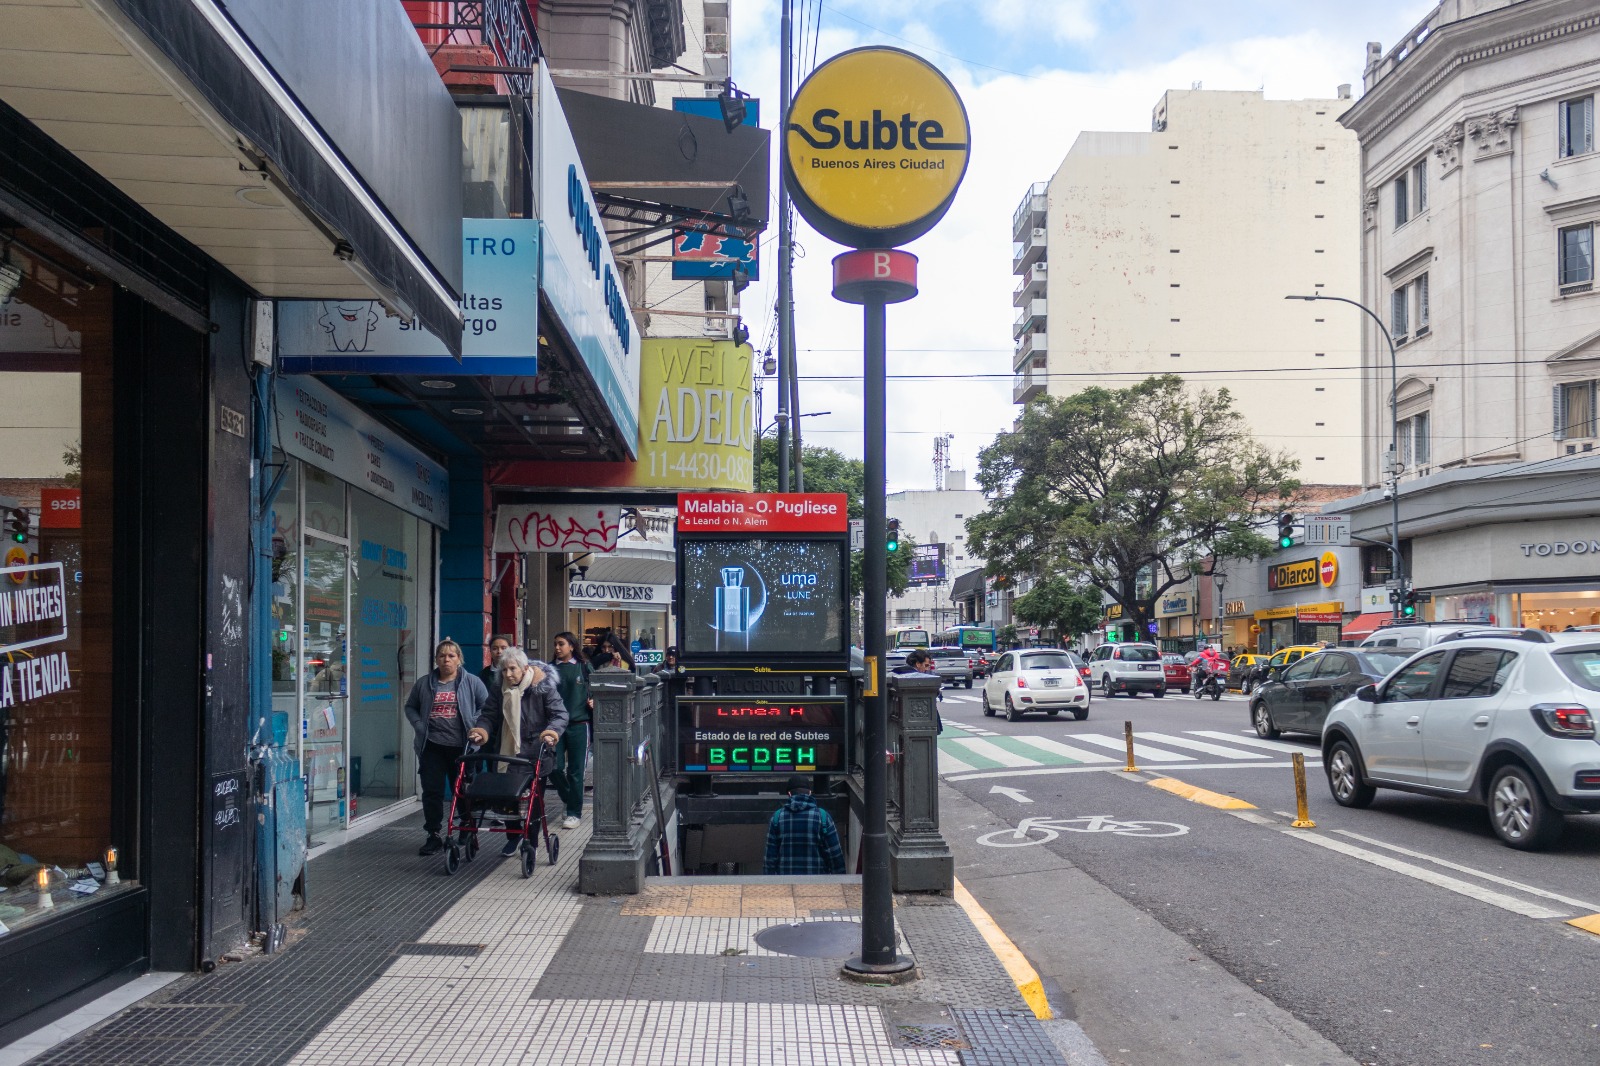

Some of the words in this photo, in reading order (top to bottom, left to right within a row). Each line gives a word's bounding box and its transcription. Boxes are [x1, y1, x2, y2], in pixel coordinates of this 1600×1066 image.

[810, 108, 946, 151] Subte
[811, 158, 860, 169] Buenos
[863, 158, 896, 169] Aires
[900, 158, 945, 170] Ciudad
[465, 237, 516, 256] TRO
[874, 252, 891, 278] B
[458, 293, 503, 311] ltas
[399, 318, 422, 331] si
[222, 408, 244, 435] 5321
[649, 450, 751, 484] 11-4430-083
[684, 500, 745, 514] Malabia
[775, 500, 838, 517] Pugliese
[684, 517, 691, 526] a
[732, 516, 742, 526] N.
[744, 516, 768, 526] Alem
[1520, 540, 1600, 557] TODOM
[781, 573, 817, 585] uma
[1279, 567, 1315, 586] Diarco
[569, 583, 654, 601] MACOWENS
[787, 591, 811, 600] LUNE
[15, 585, 62, 625] INTERES
[18, 652, 71, 702] TIENDA
[724, 679, 741, 692] AL
[743, 679, 796, 693] CENTRO
[695, 731, 730, 741] Estado
[732, 731, 746, 741] de
[748, 731, 757, 741] la
[759, 731, 777, 741] red
[779, 731, 792, 741] de
[794, 731, 830, 741] Subtes
[710, 748, 726, 764] B
[732, 748, 748, 764] C
[754, 748, 770, 764] D
[776, 748, 792, 764] E
[798, 748, 814, 764] H
